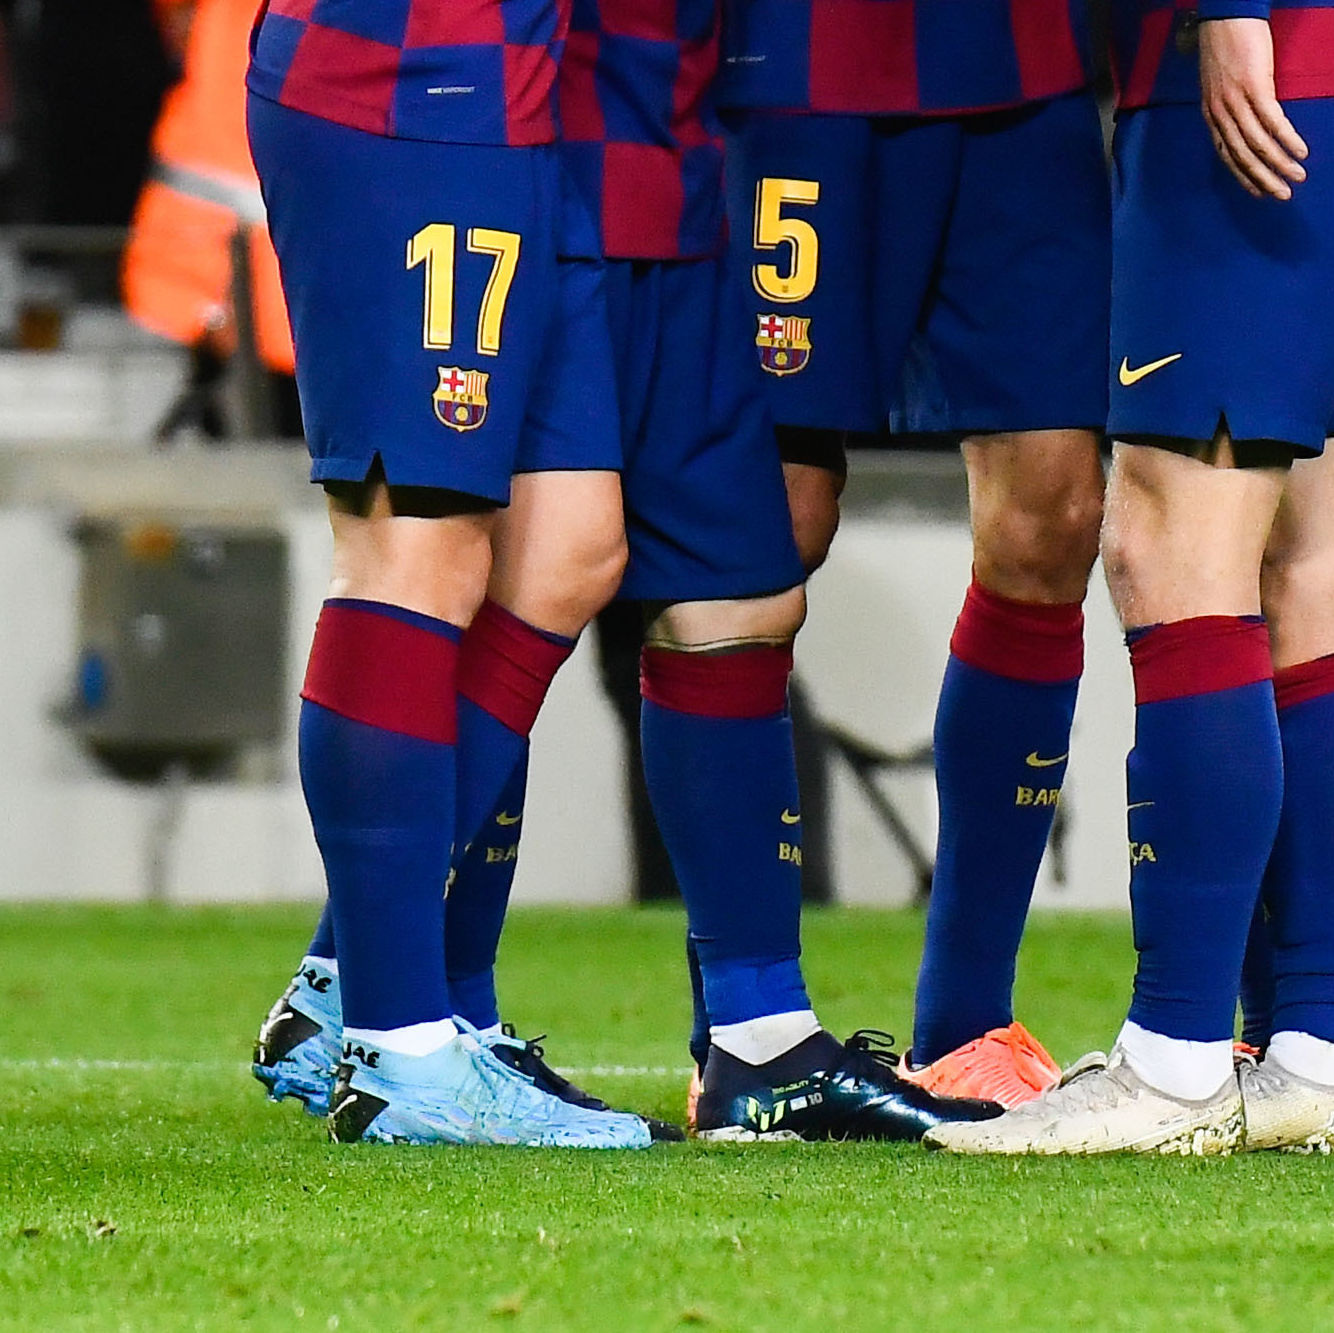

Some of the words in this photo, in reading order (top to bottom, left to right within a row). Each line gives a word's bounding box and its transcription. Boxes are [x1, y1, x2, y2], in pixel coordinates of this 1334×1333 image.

[406, 223, 521, 356] 17
[752, 178, 820, 302] 5
[807, 1092, 824, 1106] 10
